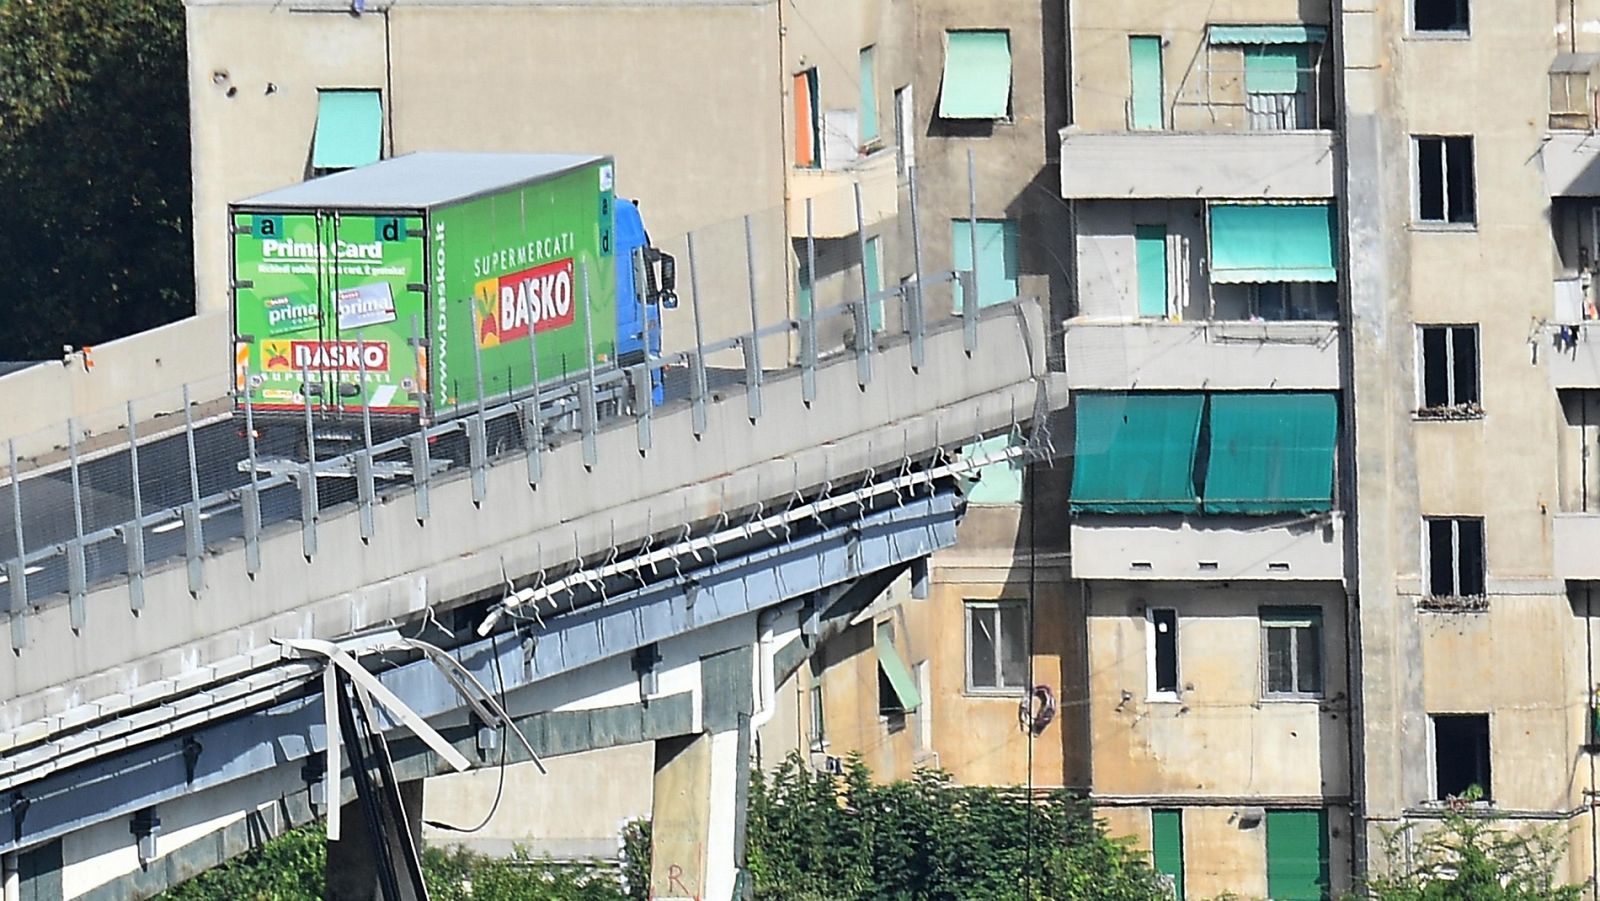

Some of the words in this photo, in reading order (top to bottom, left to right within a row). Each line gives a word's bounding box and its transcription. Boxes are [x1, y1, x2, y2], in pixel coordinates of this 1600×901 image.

[261, 217, 275, 236] a
[383, 217, 399, 242] d
[263, 240, 326, 259] Prima
[331, 240, 382, 259] Card
[473, 232, 575, 278] SUPERMERCATI
[338, 298, 389, 320] prima
[501, 271, 571, 331] BASKO
[269, 303, 318, 326] prima
[435, 221, 448, 406] www.basko.it
[295, 344, 385, 368] BASKO
[669, 864, 690, 895] R
